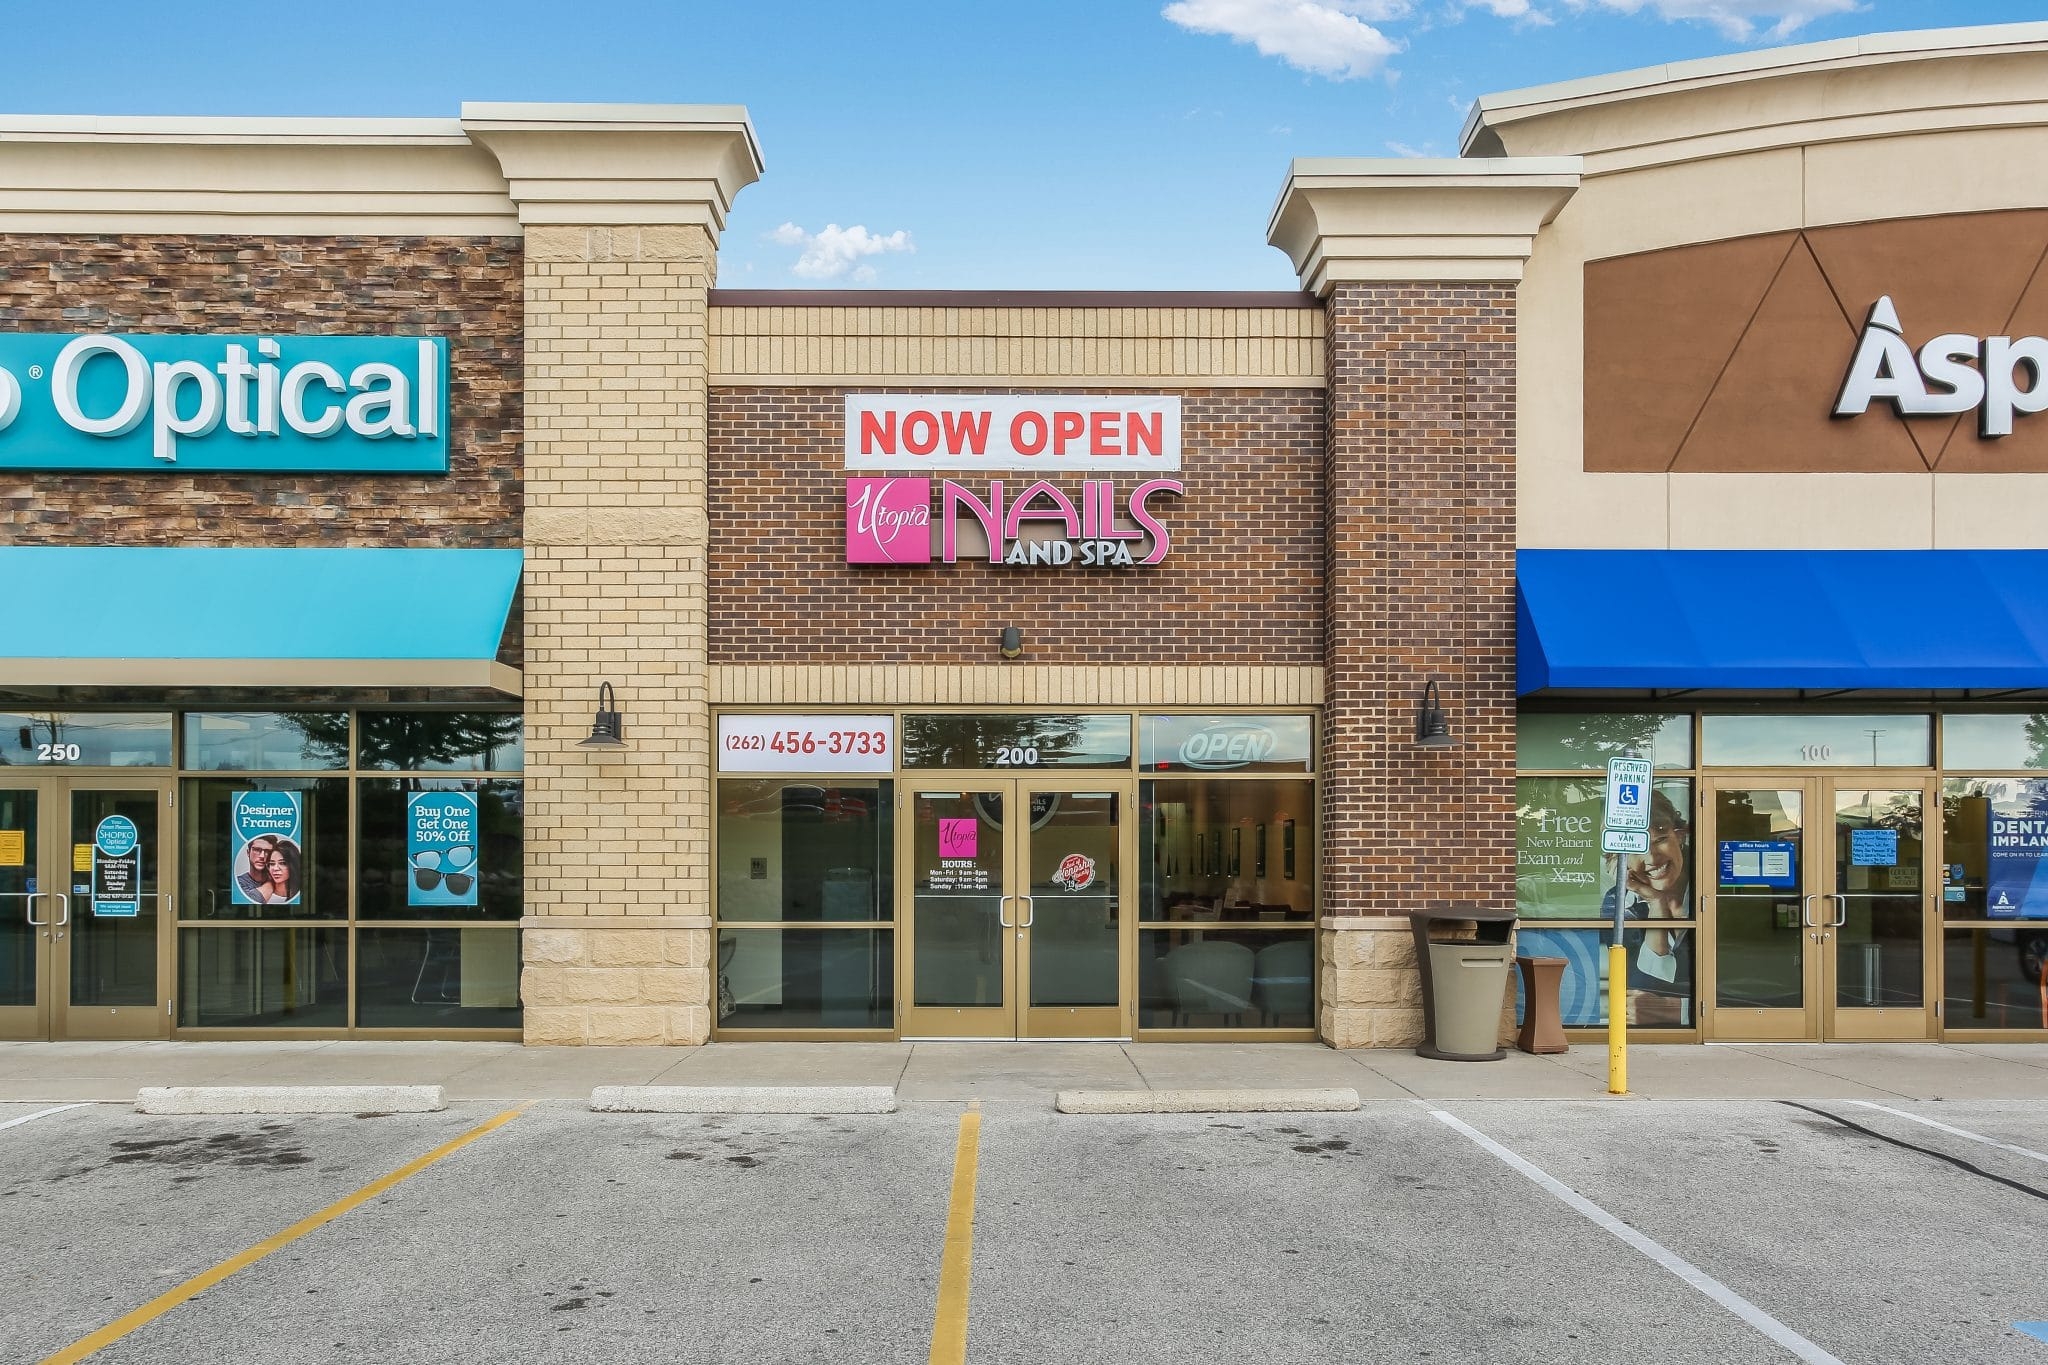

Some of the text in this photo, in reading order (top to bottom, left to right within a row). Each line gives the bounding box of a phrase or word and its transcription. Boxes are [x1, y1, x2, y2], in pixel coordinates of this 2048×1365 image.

[51, 334, 438, 462] Optical
[860, 410, 1163, 456] NOW OPEN
[848, 478, 1183, 565] Utopia NAILS
[1005, 540, 1135, 565] AND SPA
[725, 731, 886, 754] (262) 456-3733
[1185, 733, 1268, 760] OPEN
[37, 743, 80, 760] 250
[996, 747, 1038, 765] 200
[1800, 744, 1830, 761] 100
[1613, 761, 1648, 773] RESERVED
[1614, 773, 1646, 784] PARKING
[240, 804, 294, 818] Designer
[415, 805, 470, 820] Buy One
[242, 817, 292, 828] Frames
[417, 818, 468, 829] Get One
[1538, 808, 1592, 833] Free
[1608, 816, 1645, 827] THIS SPACE
[1992, 821, 2048, 834] DENT
[99, 829, 134, 839] SHOPKO
[416, 831, 471, 842] 50% Off
[940, 820, 976, 856] Utopia
[1618, 834, 1634, 842] VAN
[1526, 836, 1594, 848] New Patient
[1517, 850, 1584, 865] Exam and
[1551, 867, 1595, 887] X-rays
